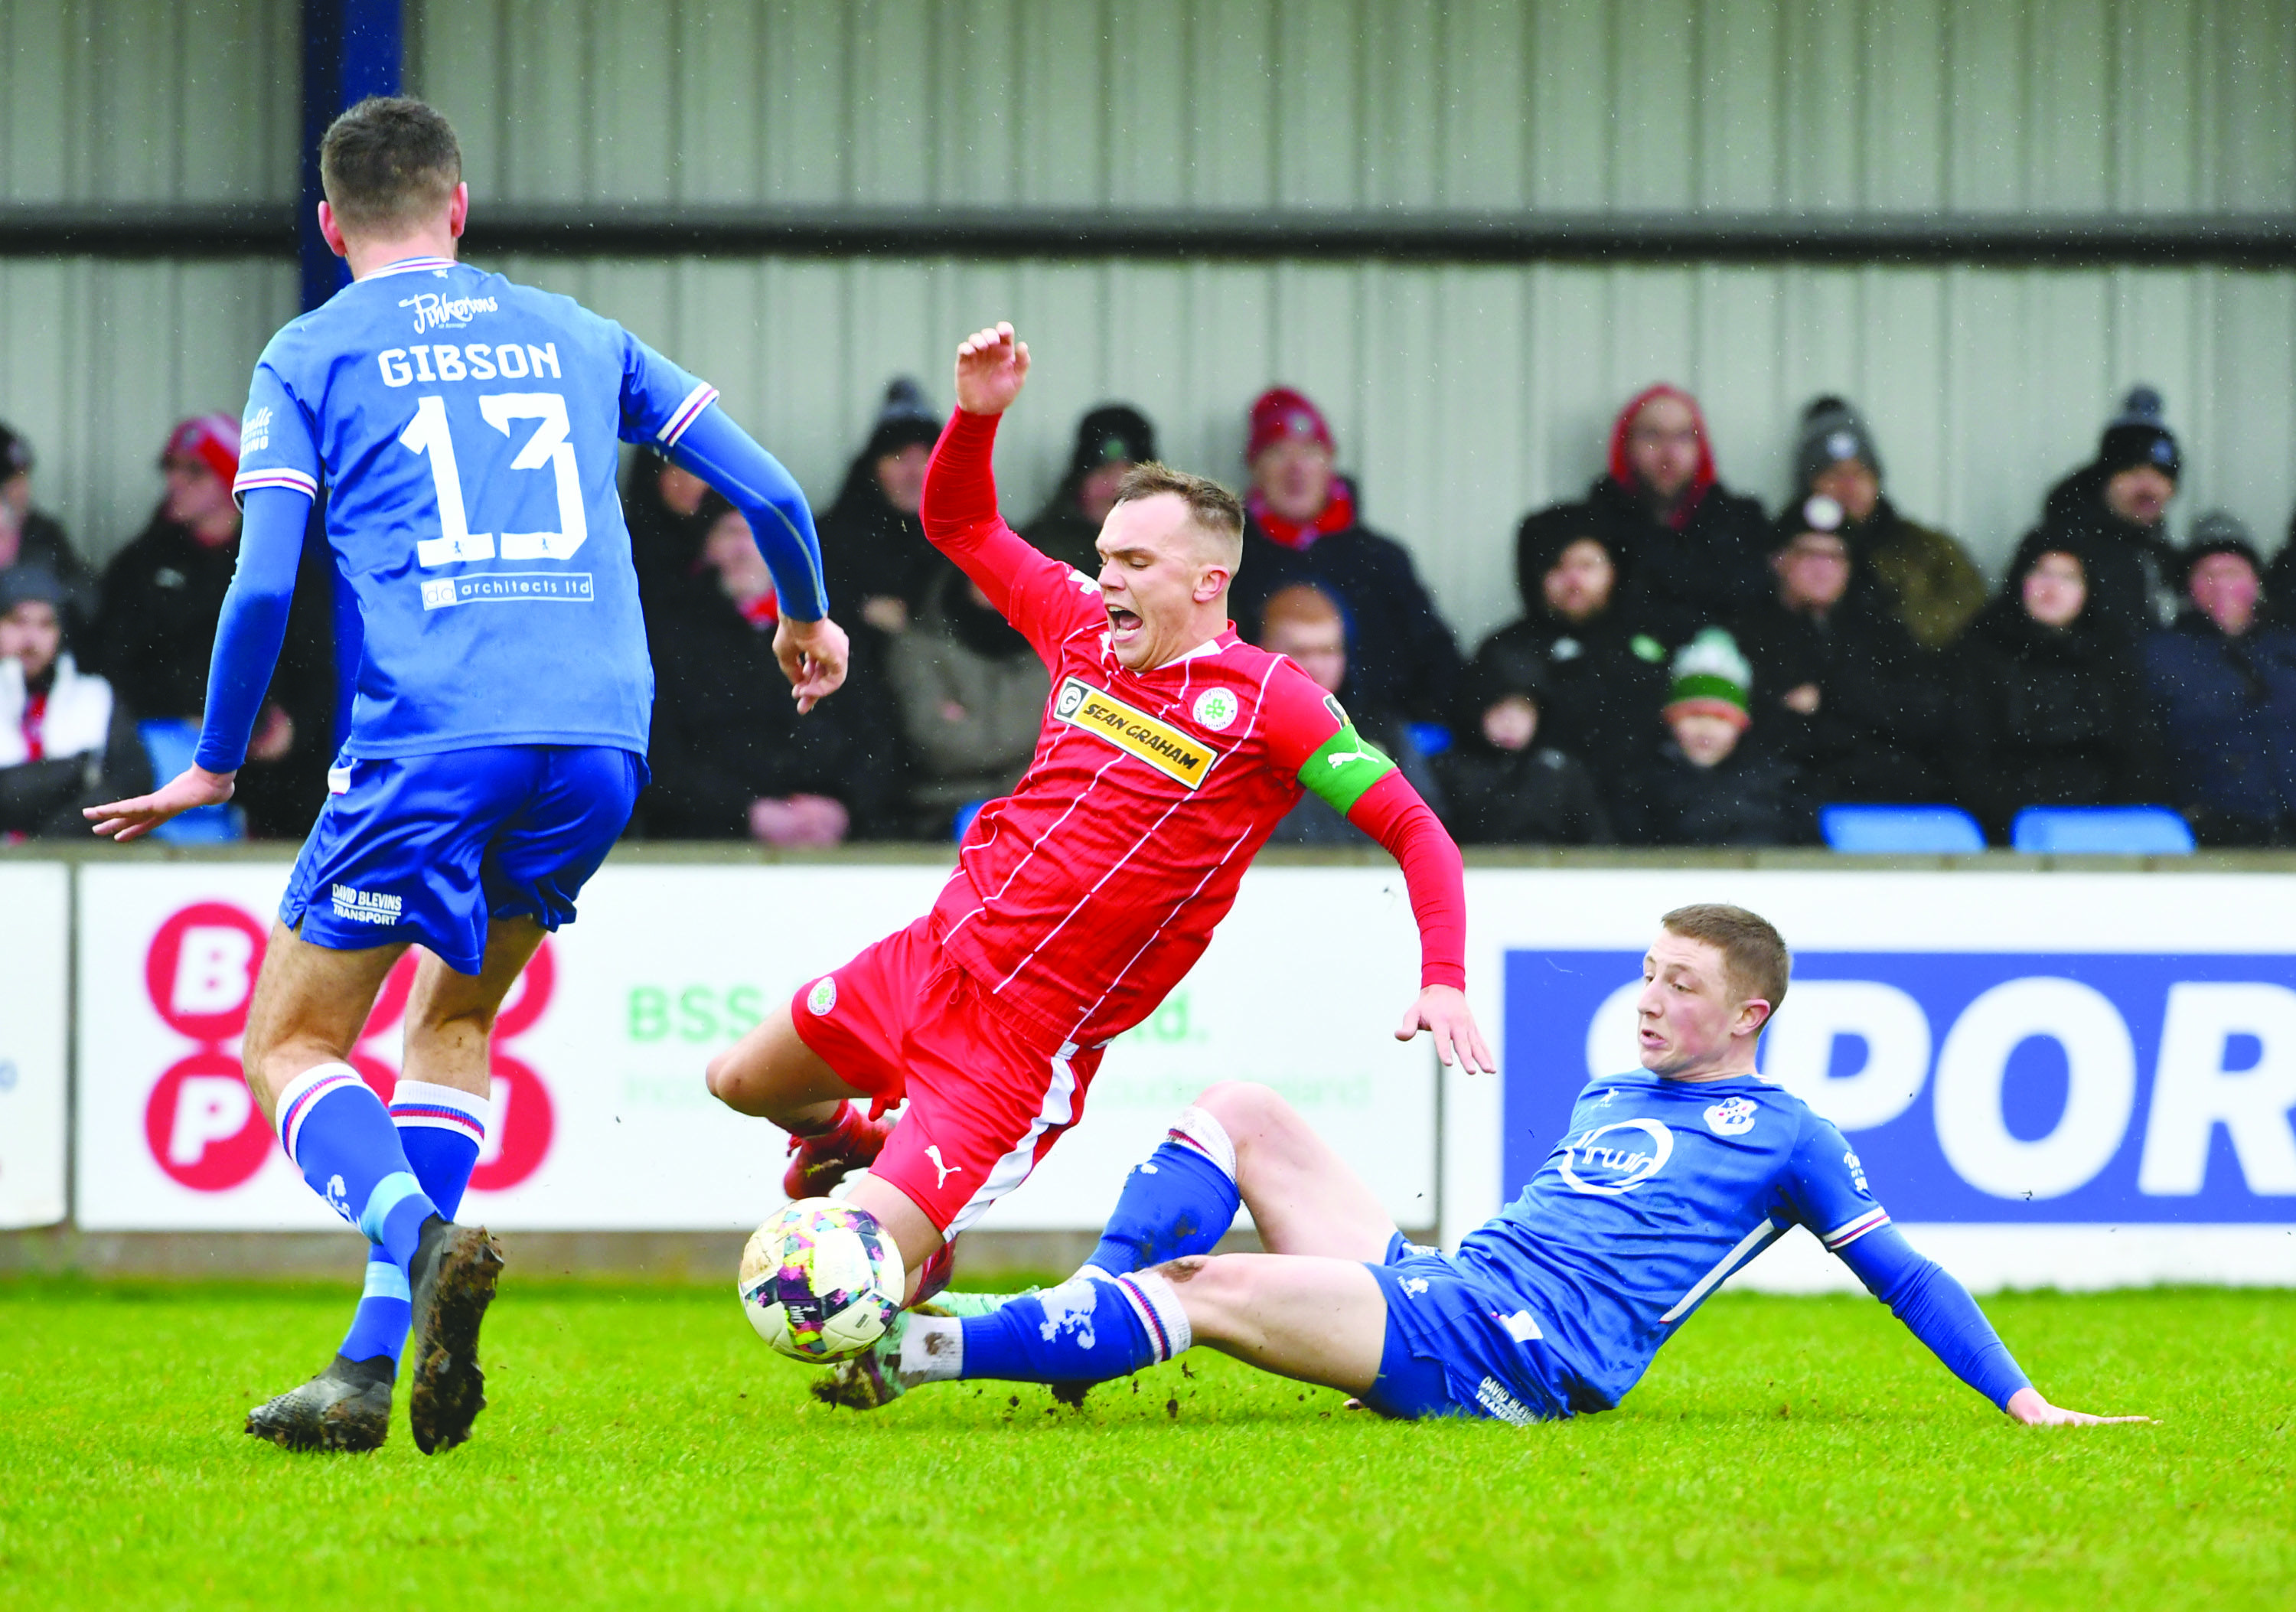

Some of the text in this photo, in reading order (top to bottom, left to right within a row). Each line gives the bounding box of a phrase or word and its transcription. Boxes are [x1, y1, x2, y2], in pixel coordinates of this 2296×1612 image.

[377, 342, 562, 388] GIBSON
[399, 393, 588, 567] 13
[461, 579, 558, 596] architects
[566, 579, 589, 594] ltd
[1084, 703, 1200, 770] SEAN GRAHAM
[332, 883, 403, 912] DAVID BLEVINS
[333, 903, 397, 926] TRANSPORT
[1479, 1375, 1510, 1403] DAVID
